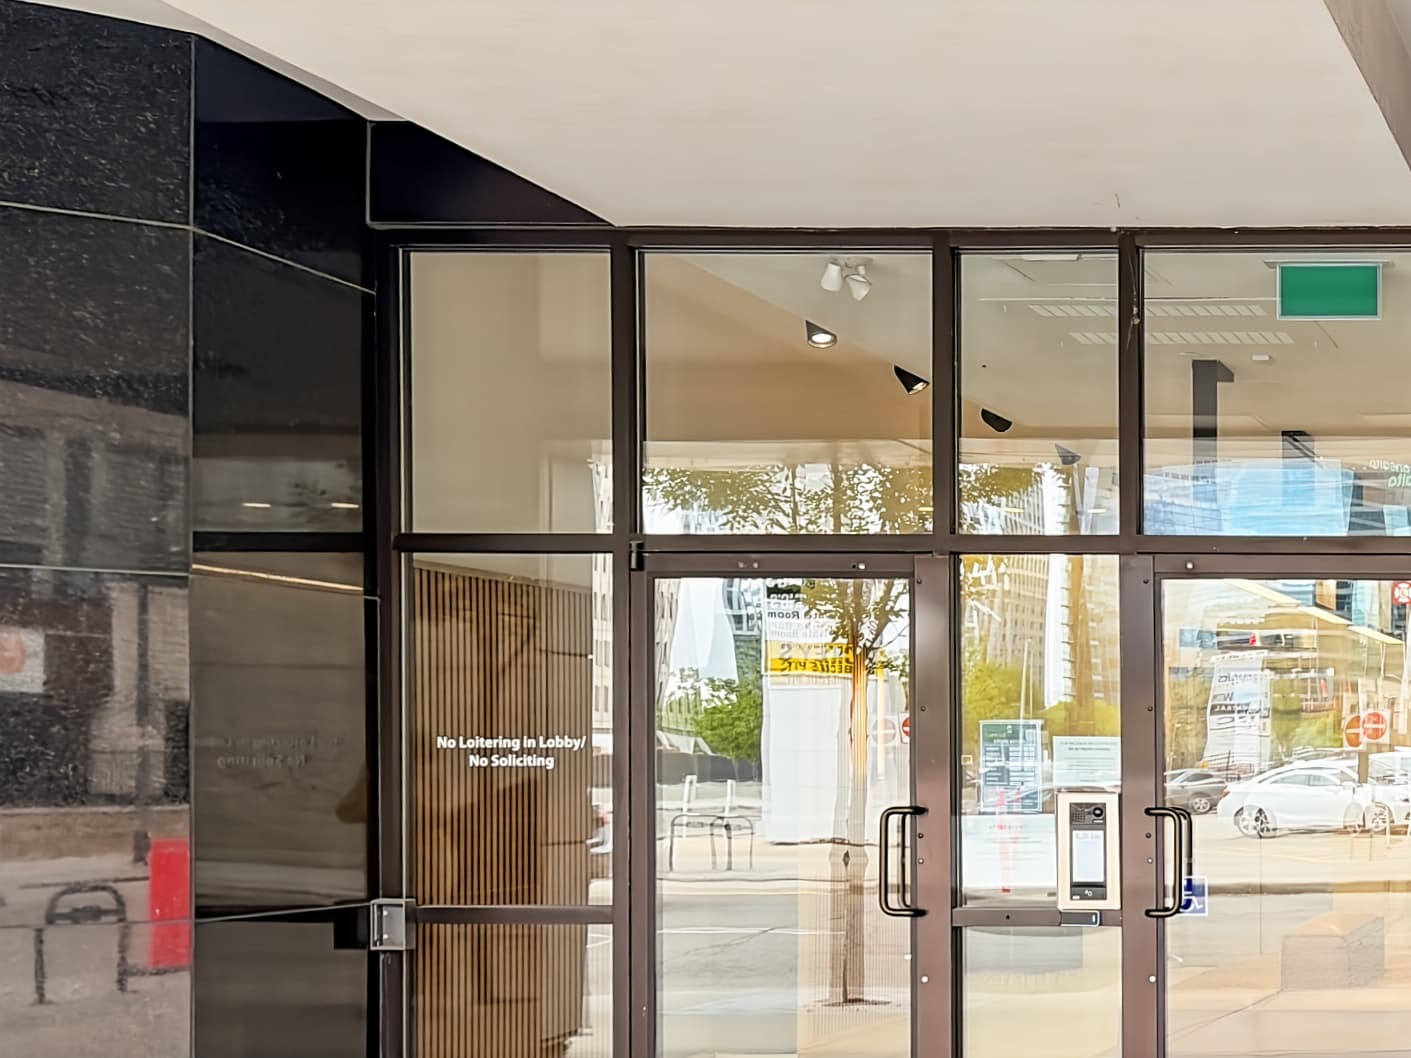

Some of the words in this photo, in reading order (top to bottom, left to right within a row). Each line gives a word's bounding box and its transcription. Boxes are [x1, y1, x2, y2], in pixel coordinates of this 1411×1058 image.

[437, 735, 456, 748] No
[459, 735, 521, 751] Loitering
[523, 735, 536, 748] in
[539, 734, 587, 751] Lobby/
[469, 754, 488, 767] No
[491, 754, 555, 769] Soliciting
